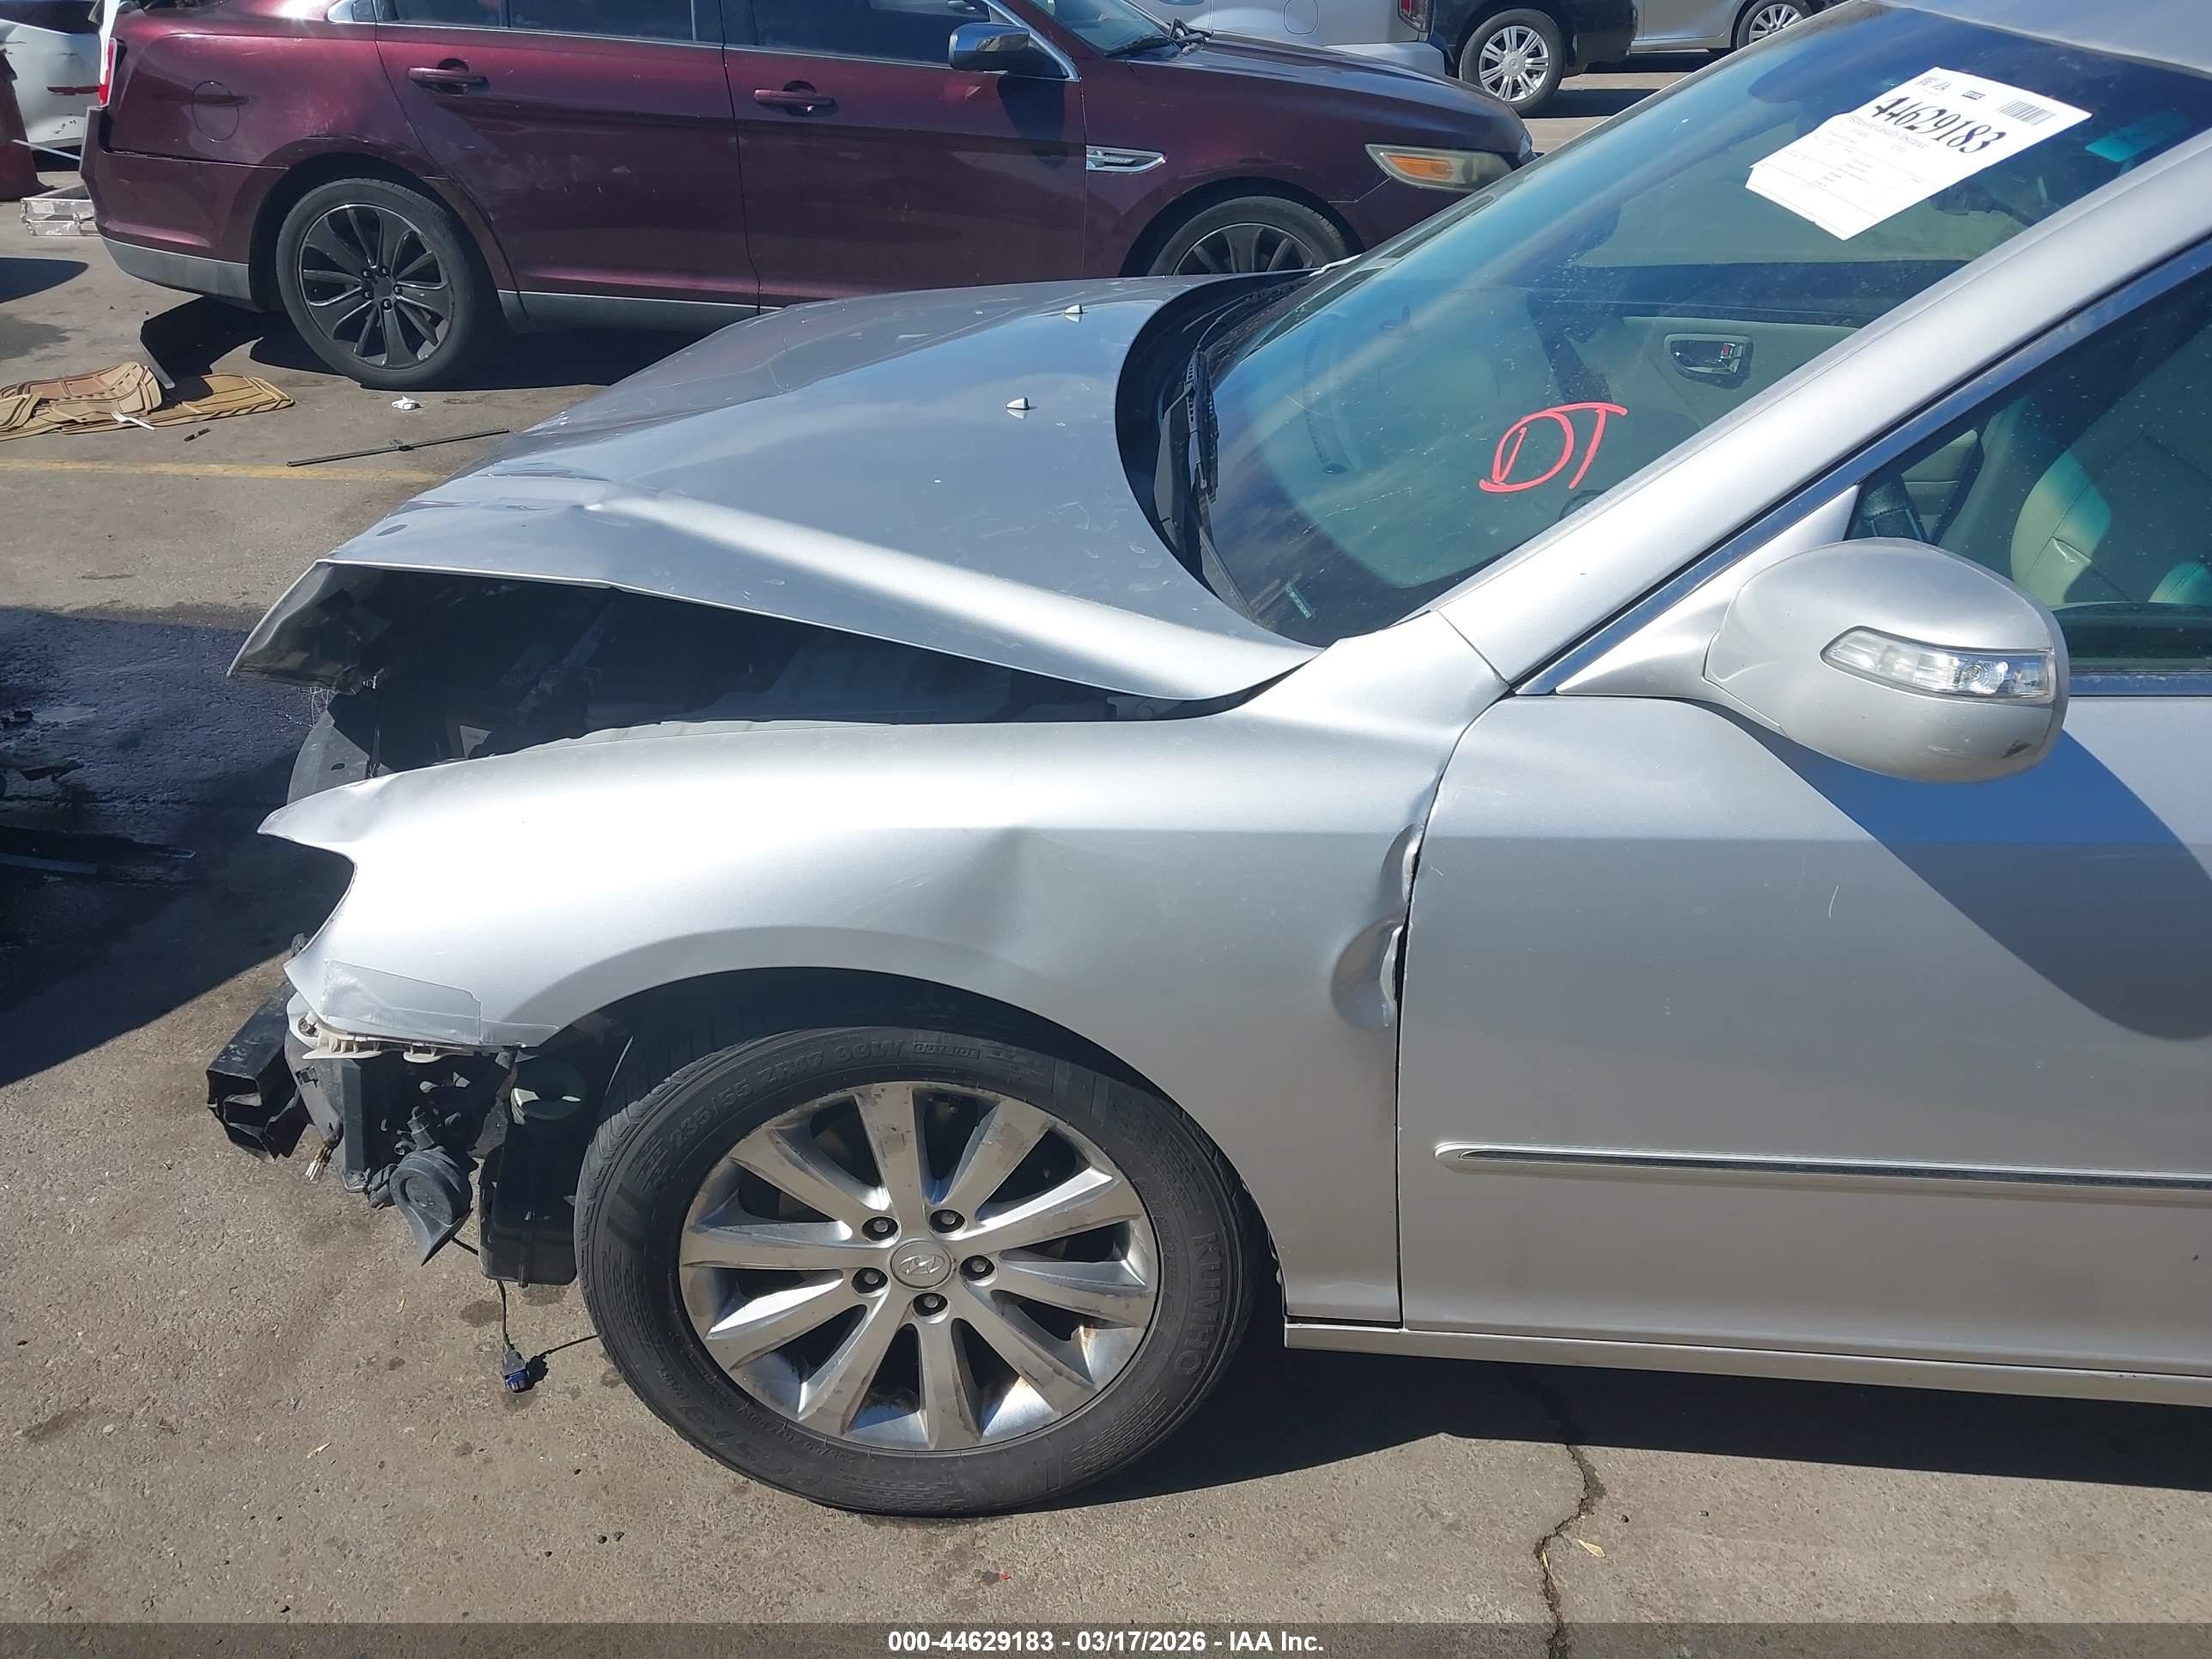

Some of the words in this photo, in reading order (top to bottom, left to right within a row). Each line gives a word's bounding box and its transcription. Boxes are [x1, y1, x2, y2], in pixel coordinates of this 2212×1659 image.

[1872, 96, 2007, 154] 44629183
[668, 1078, 753, 1149] 235/55
[757, 1050, 824, 1085] ZR17
[835, 1040, 906, 1065] 99W
[1175, 1231, 1223, 1375] KUMHO
